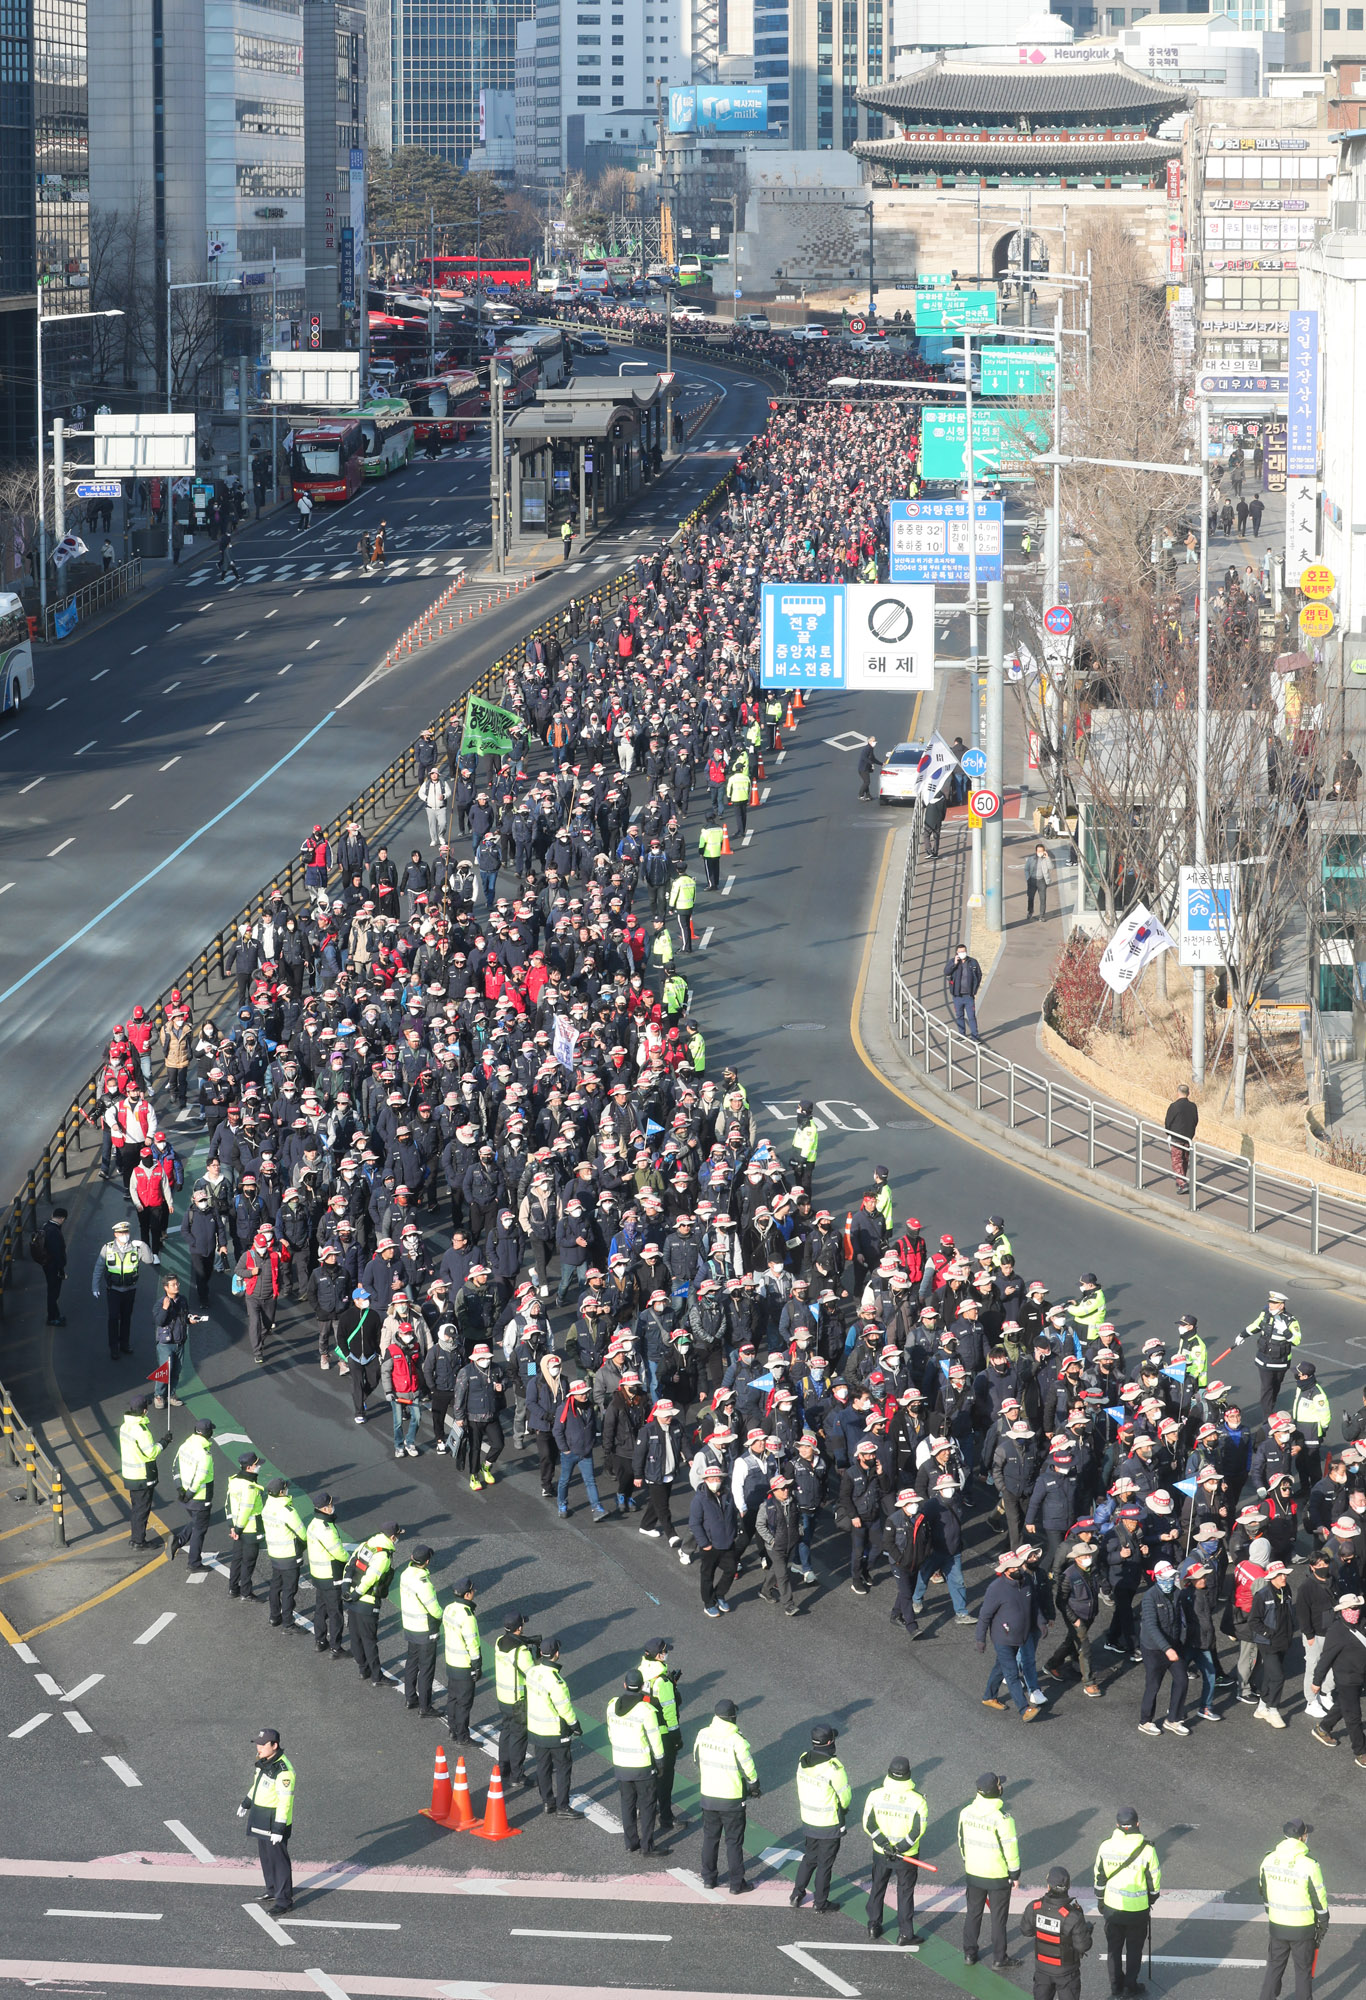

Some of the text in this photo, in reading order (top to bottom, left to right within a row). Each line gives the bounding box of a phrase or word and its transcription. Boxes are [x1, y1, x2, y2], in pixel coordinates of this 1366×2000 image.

[1054, 48, 1110, 61] Heungkuk
[1148, 48, 1178, 56] 흥국생명
[1148, 58, 1178, 66] 흥국화재
[734, 108, 758, 118] miilk
[1213, 200, 1231, 209] 사교
[1252, 200, 1281, 209] 스포츠
[325, 192, 334, 248] 치과재료
[1263, 260, 1281, 270] 포토
[1205, 360, 1259, 370] 대신의원
[1296, 316, 1312, 419] 경일군장상사
[1218, 380, 1280, 389] 대우사약국
[1185, 400, 1195, 410] 약
[938, 412, 966, 423] 광화문
[946, 427, 965, 436] 시청
[1228, 424, 1239, 436] 약
[1247, 424, 1259, 437] 약
[922, 505, 987, 516] 차량운행한
[897, 524, 923, 535] 총중량
[1298, 486, 1313, 563] 大丈夫
[897, 540, 922, 551] 축하중
[1307, 571, 1329, 582] 호프
[1304, 585, 1332, 593] 세계맥주
[1304, 610, 1328, 621] 캡틴
[789, 617, 818, 631] 전용
[797, 631, 810, 644] 끝
[776, 644, 832, 659] 중앙차로
[775, 662, 832, 677] 버스전용
[868, 656, 914, 673] 해제
[978, 797, 993, 811] 50
[1186, 873, 1233, 884] 세종대로
[762, 1100, 880, 1132] 50
[701, 1742, 729, 1754] POLICE
[798, 1775, 822, 1788] POLICE
[876, 1810, 910, 1820] POLICE
[964, 1821, 992, 1832] POLICE
[1267, 1874, 1299, 1885] POLICE
